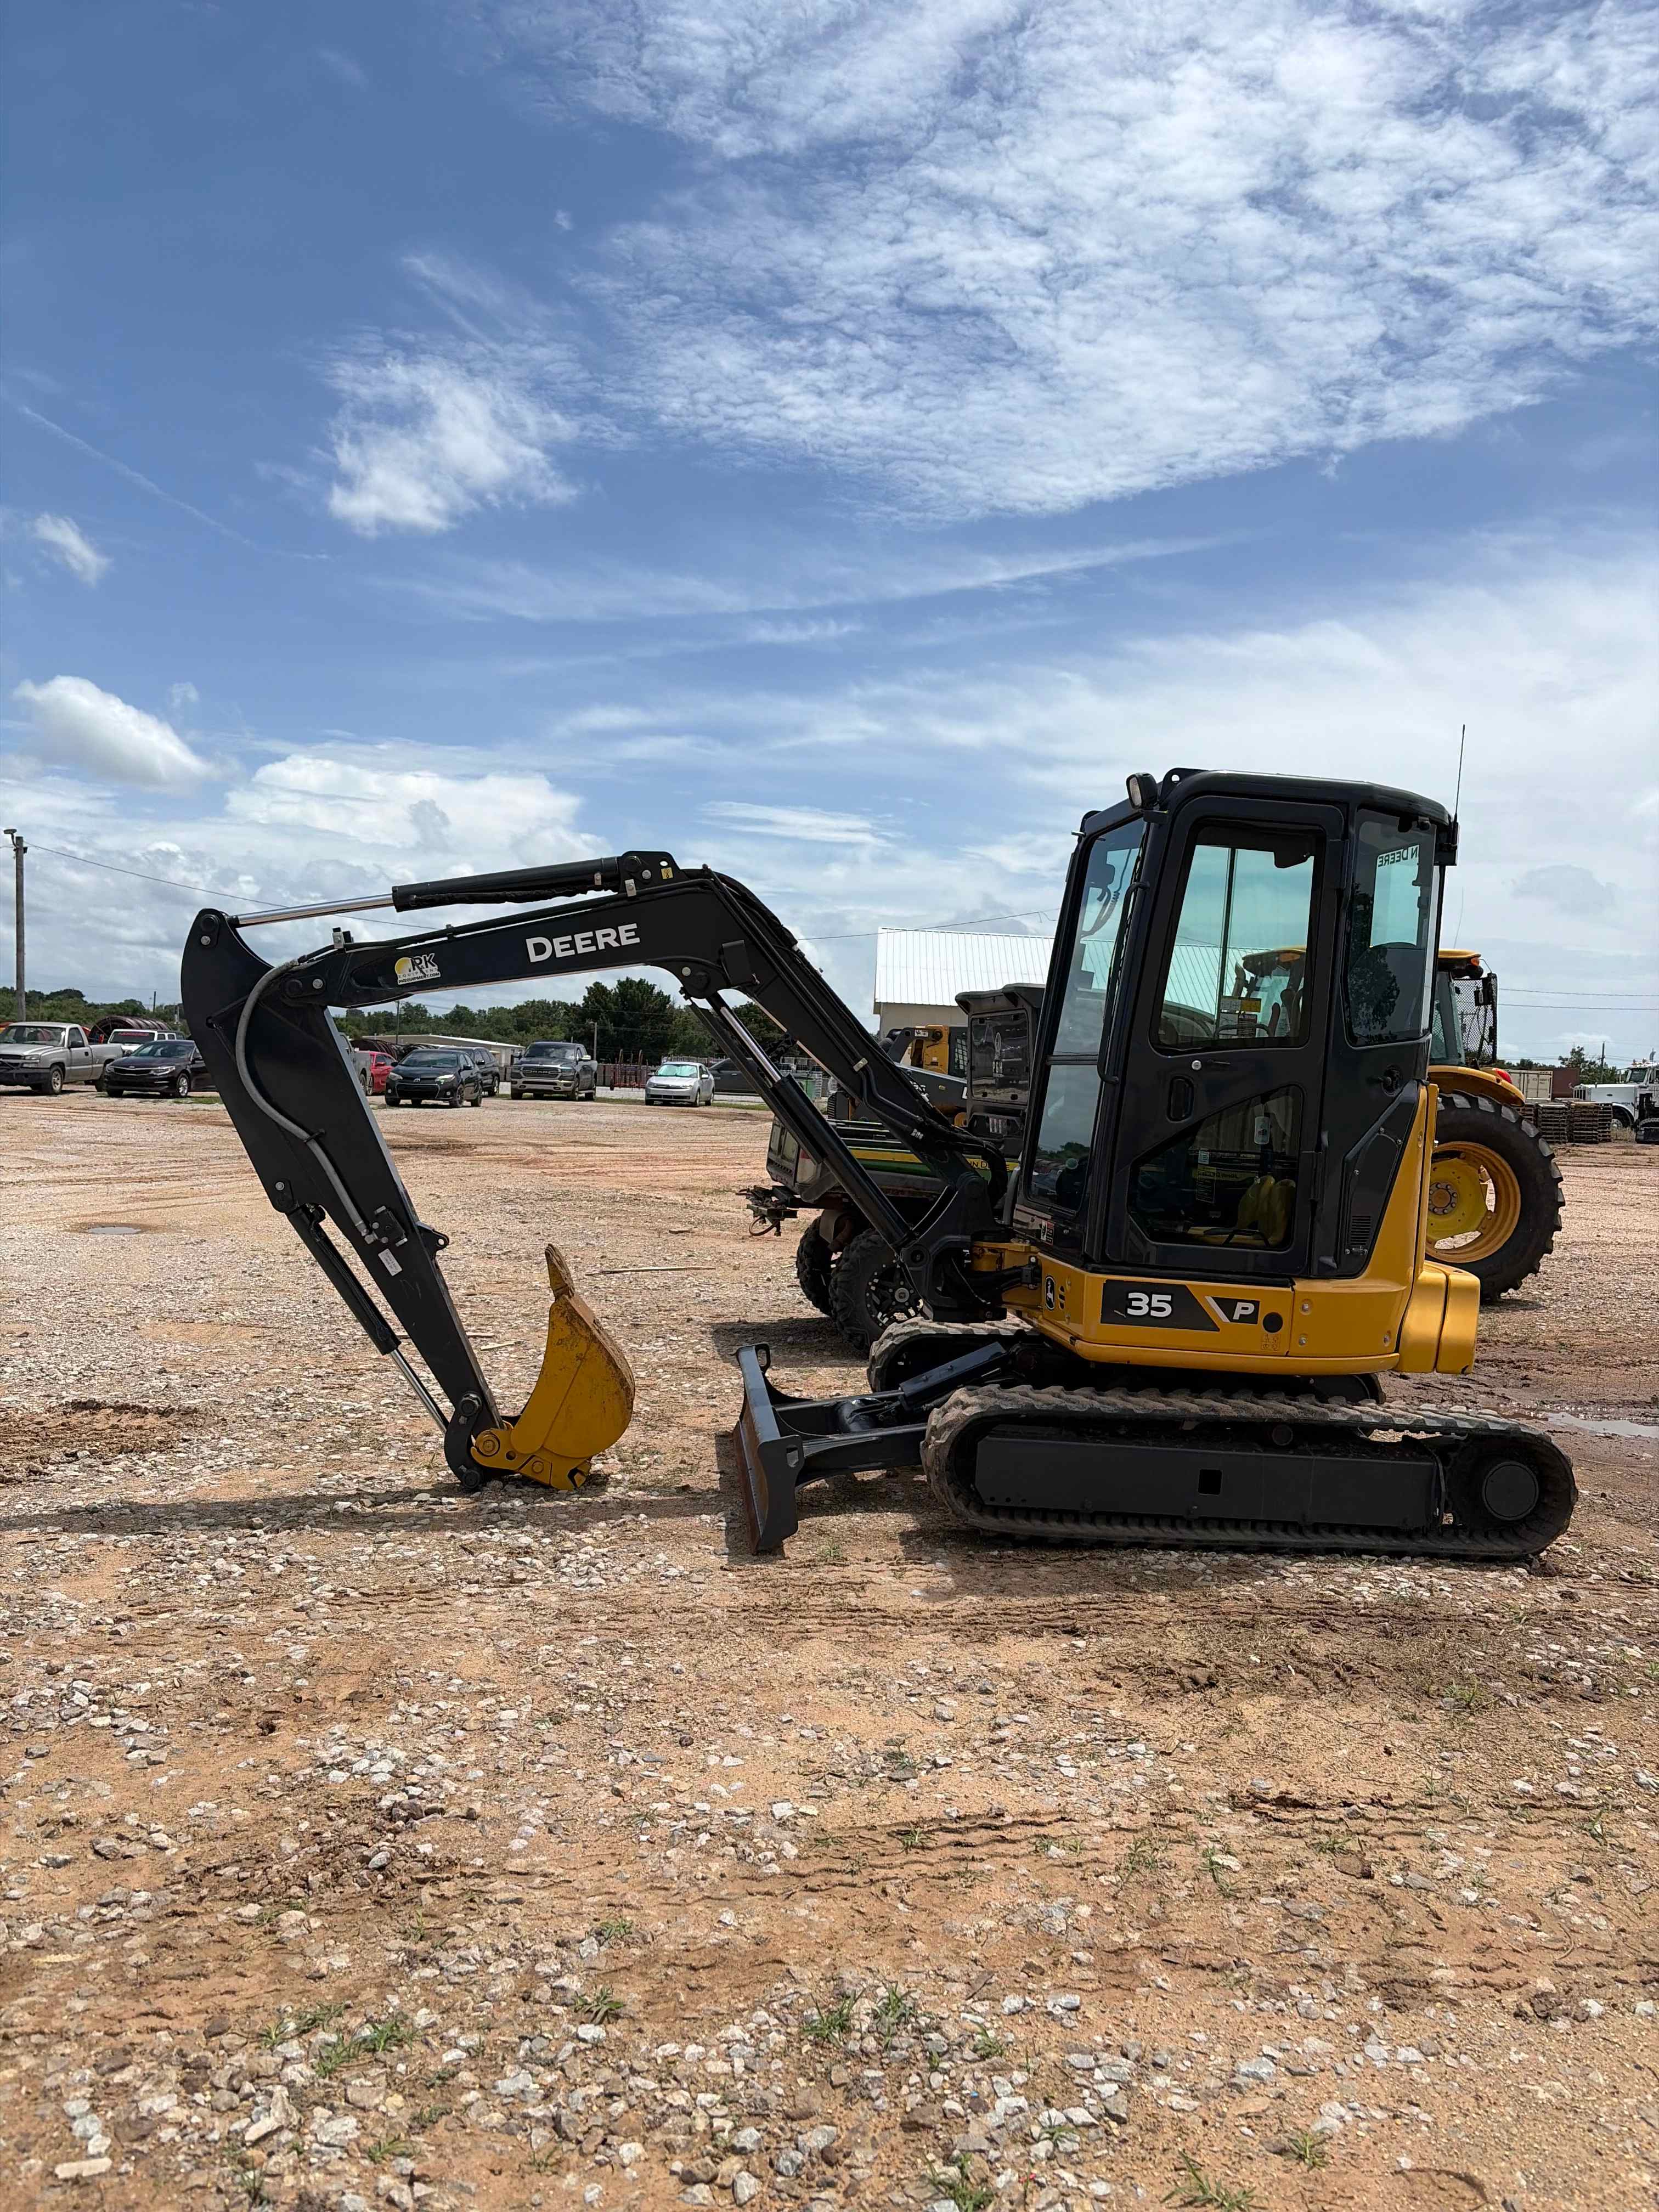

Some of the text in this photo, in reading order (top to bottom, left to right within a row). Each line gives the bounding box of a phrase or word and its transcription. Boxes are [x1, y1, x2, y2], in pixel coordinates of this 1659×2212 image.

[526, 923, 640, 963] DEERE
[1127, 1292, 1255, 1320] 35 P
